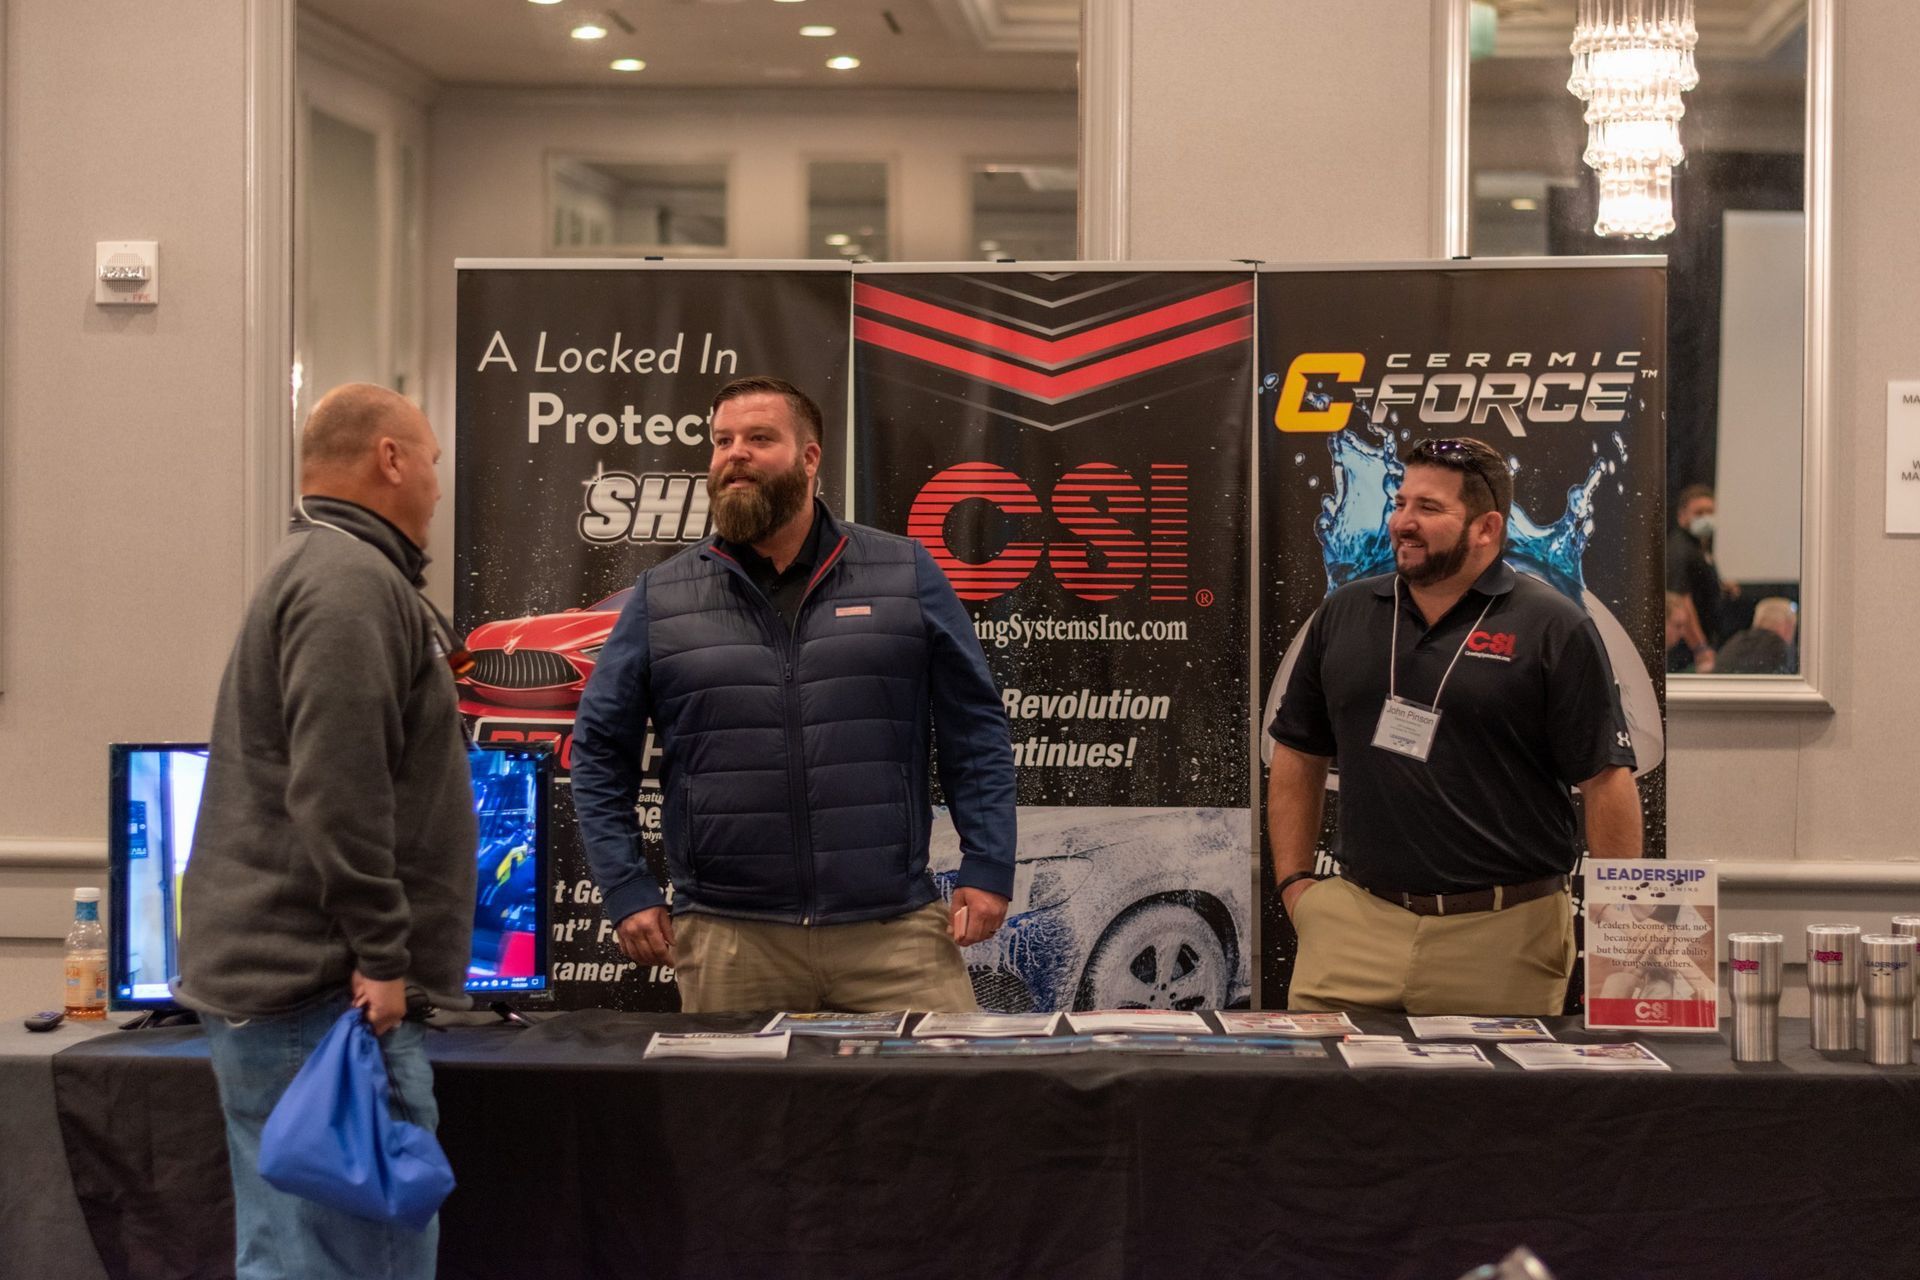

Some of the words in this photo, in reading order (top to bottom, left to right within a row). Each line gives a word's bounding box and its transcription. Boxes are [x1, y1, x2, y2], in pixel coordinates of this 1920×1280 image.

[477, 330, 518, 373] A
[534, 330, 685, 374] Locked
[699, 332, 738, 375] In
[1386, 351, 1642, 368] CERAMIC
[1275, 352, 1635, 437] C-FORCE
[579, 472, 718, 544] SHI
[907, 462, 1188, 601] CSI
[973, 612, 1188, 648] ingSystemsInc.com
[1468, 631, 1515, 656] CSI
[1002, 688, 1170, 720] Revolution
[1011, 736, 1137, 767] ntinues!
[1597, 868, 1706, 882] LEADERSHIP
[1597, 921, 1630, 930] Leaders
[1632, 922, 1665, 931] become
[1693, 923, 1708, 932] not
[1604, 933, 1638, 942] because
[1640, 934, 1648, 942] of
[1650, 934, 1671, 943] their
[1596, 945, 1611, 954] but
[1613, 945, 1646, 955] because
[1658, 947, 1680, 956] their
[1681, 947, 1708, 957] ability
[1622, 960, 1661, 969] empower
